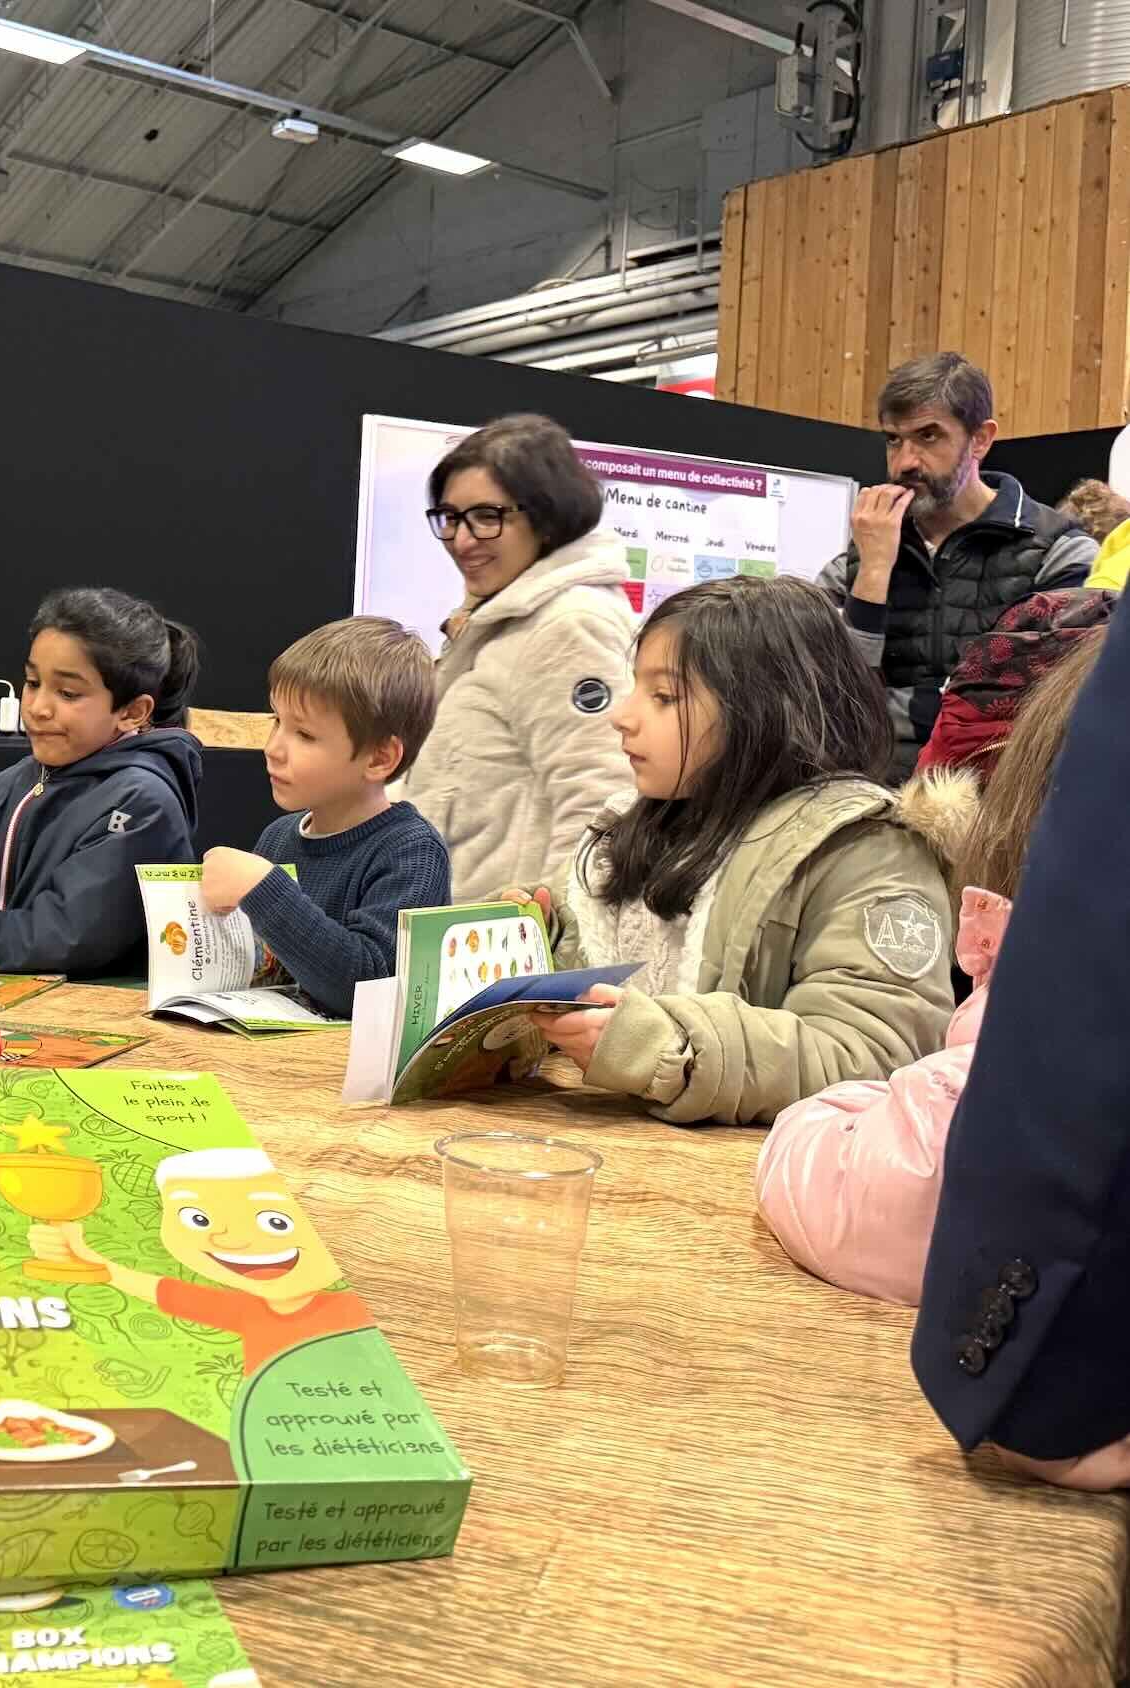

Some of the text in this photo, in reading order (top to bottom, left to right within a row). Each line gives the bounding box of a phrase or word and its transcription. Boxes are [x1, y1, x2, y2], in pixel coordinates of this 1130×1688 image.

[585, 458, 641, 476] composait
[642, 466, 657, 477] un
[657, 467, 686, 482] menu
[687, 470, 701, 484] de
[701, 473, 754, 491] collectivité
[605, 487, 708, 515] Menu de cantine
[655, 530, 690, 544] Mercredi
[186, 900, 203, 981] Clémentine
[411, 983, 422, 1025] HIVER
[130, 1080, 186, 1093] Faites
[123, 1095, 211, 1110] le plein de
[145, 1112, 196, 1126] sport
[286, 1380, 382, 1398] Testé et
[266, 1409, 421, 1432] approuvé par
[264, 1437, 445, 1456] les diététiciens
[262, 1497, 446, 1525] Testé et approuvé
[254, 1530, 444, 1560] par les diététiciens
[12, 1627, 87, 1648] BOX
